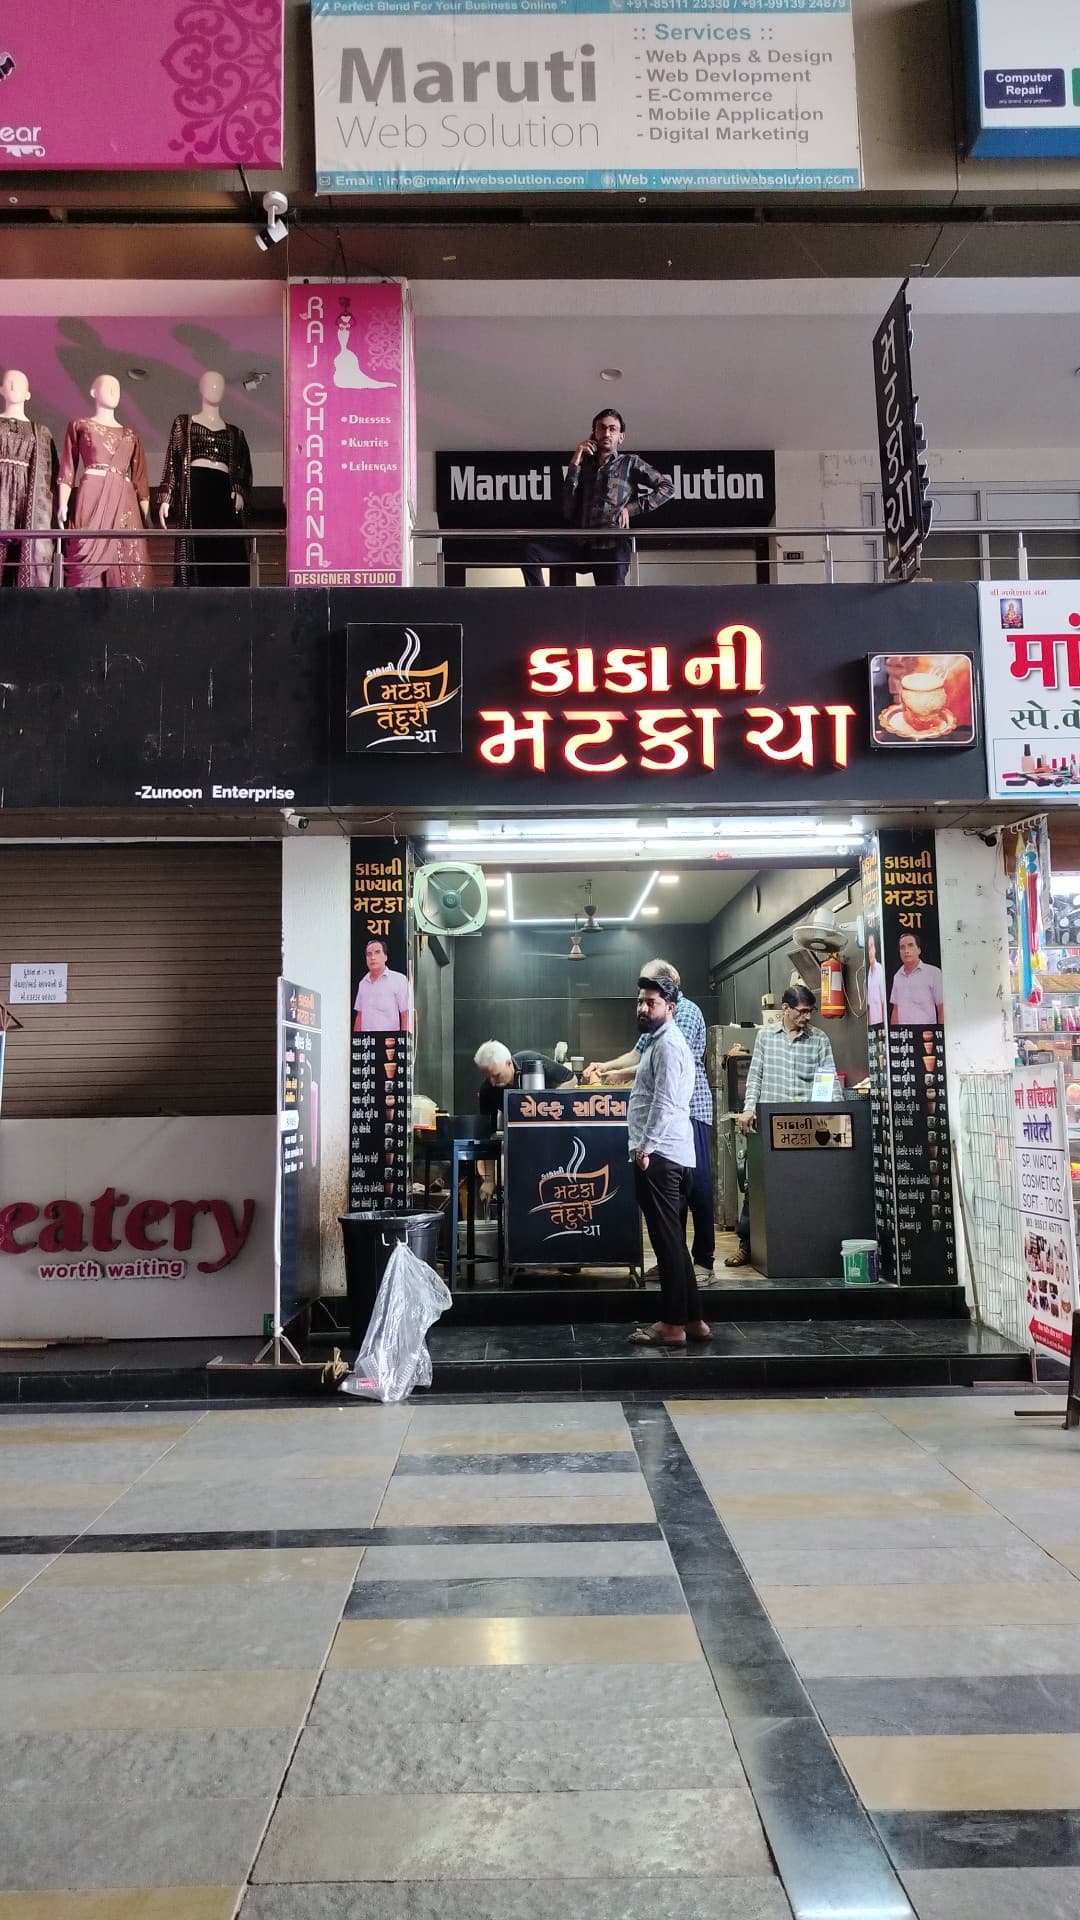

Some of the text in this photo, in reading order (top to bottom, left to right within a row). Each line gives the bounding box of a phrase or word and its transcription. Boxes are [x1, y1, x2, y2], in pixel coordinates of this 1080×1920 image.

[334, 2, 374, 11] Perfect
[378, 1, 411, 11] Blend
[414, 1, 433, 10] For
[437, 1, 462, 10] Your
[465, 0, 517, 10] Business
[521, 0, 557, 9] Online
[655, 22, 751, 41] Services
[646, 48, 833, 67] Web Apps & Design
[339, 44, 597, 104] Maruti
[647, 68, 811, 86] Web Devlopment
[996, 73, 1053, 84] Computer
[648, 88, 773, 103] E-Commerce
[1006, 86, 1043, 96] Repair
[649, 107, 823, 124] Mobile Application
[336, 114, 599, 149] Web Solution
[650, 127, 809, 143] Digital Marketing
[336, 175, 373, 187] Email
[387, 174, 585, 189] info@marutiwebsolution.com
[619, 174, 646, 185] Web
[660, 173, 855, 187] www.marutiwebsolution.com
[305, 295, 324, 369] RAJ
[302, 383, 328, 566] GHARANA
[450, 466, 552, 501] Maruti
[295, 571, 396, 585] DESIGNER STUDIO
[528, 624, 763, 695] કાકાની
[381, 681, 431, 701] મટકા
[415, 729, 437, 743] ચા
[479, 704, 855, 771] મટકા ચા
[212, 785, 295, 802] Enterprise
[355, 858, 402, 876] કાકાની
[884, 850, 932, 870] કાકાની
[354, 897, 404, 914] મટકા
[884, 889, 934, 907] મટકા
[367, 919, 391, 936] ચા
[899, 912, 922, 929] ચા
[1033, 1154, 1057, 1171] WATCH
[554, 1183, 595, 1200] મટકા
[1022, 1173, 1060, 1192] COSMETICS
[1022, 1193, 1063, 1214] SOFT TOYS
[0, 1187, 255, 1274] eatery
[583, 1224, 601, 1237] ચા
[38, 1259, 184, 1279] worth waiting
